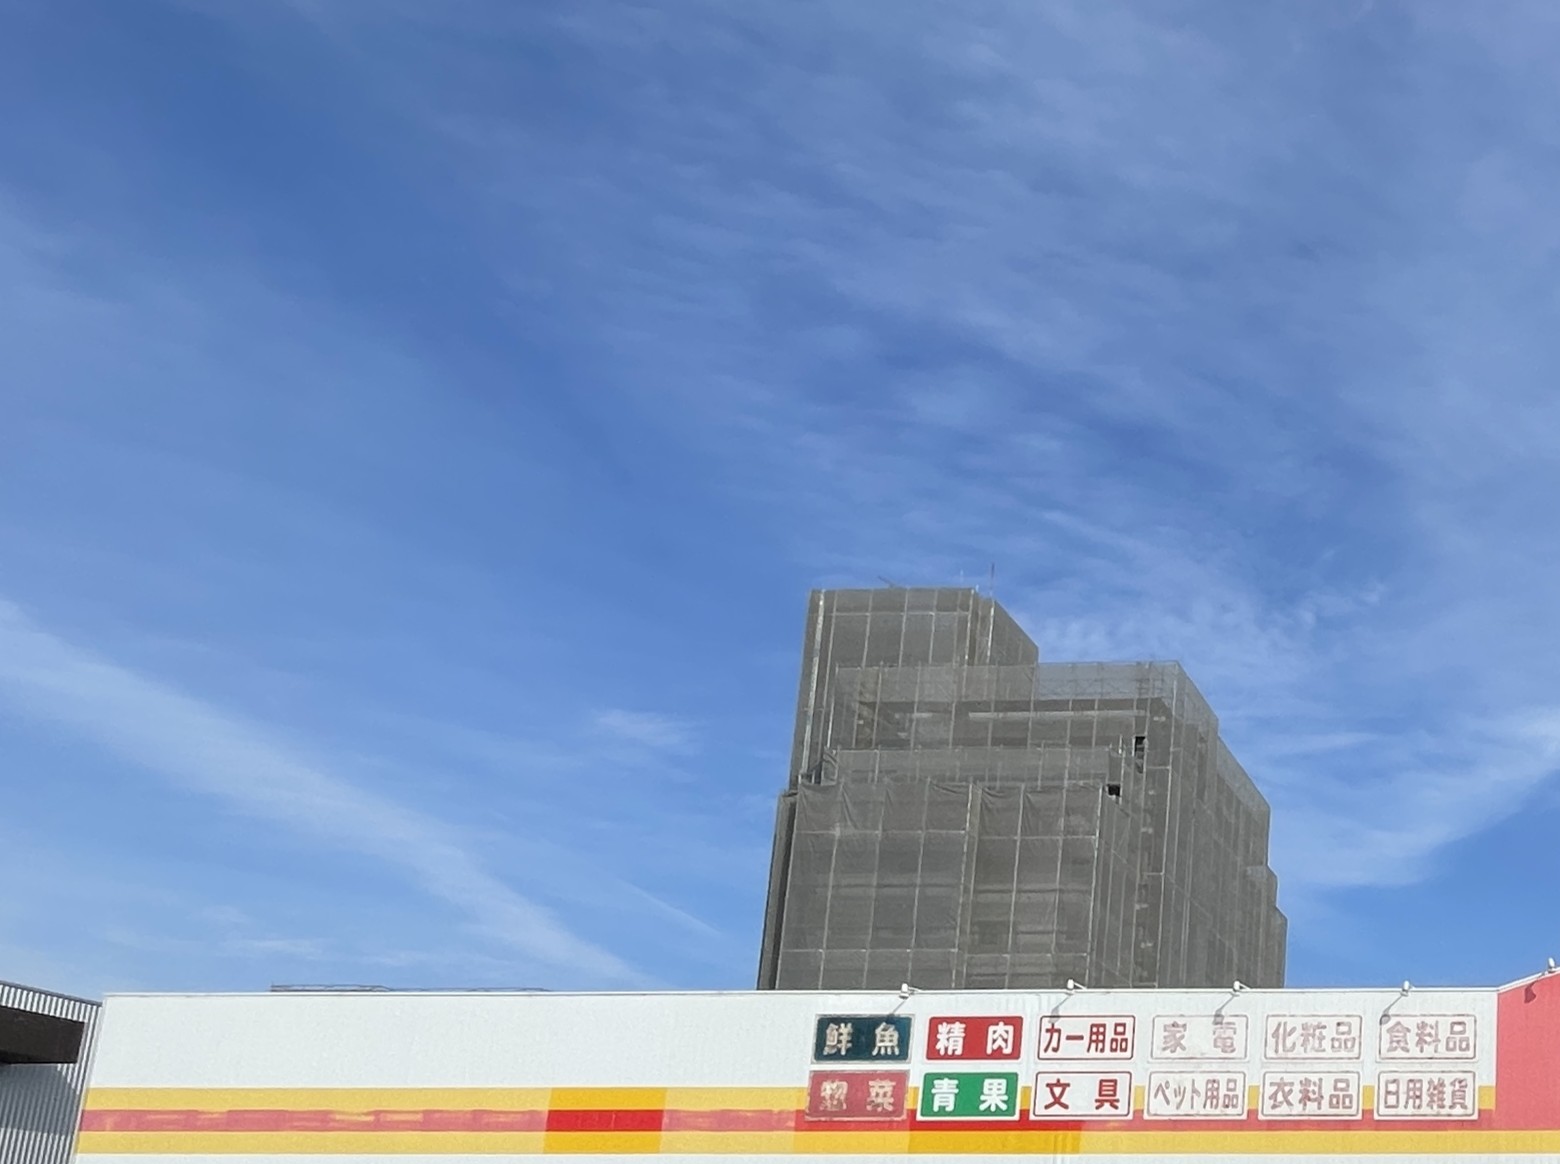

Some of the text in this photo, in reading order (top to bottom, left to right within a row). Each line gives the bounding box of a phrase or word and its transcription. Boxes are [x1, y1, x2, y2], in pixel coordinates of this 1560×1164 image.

[823, 1023, 900, 1056] 鮮魚
[935, 1021, 1014, 1056] 精肉
[1044, 1022, 1128, 1053] カー用品
[1162, 1021, 1237, 1053] 家電
[1271, 1021, 1356, 1053] 化粧品
[1386, 1021, 1470, 1053] 食料品
[931, 1078, 1008, 1112] 青果
[1044, 1078, 1120, 1110] 文具
[1154, 1078, 1239, 1110] ペット用品
[1268, 1077, 1353, 1110] 衣料品
[1384, 1077, 1468, 1110] 日用雑貨
